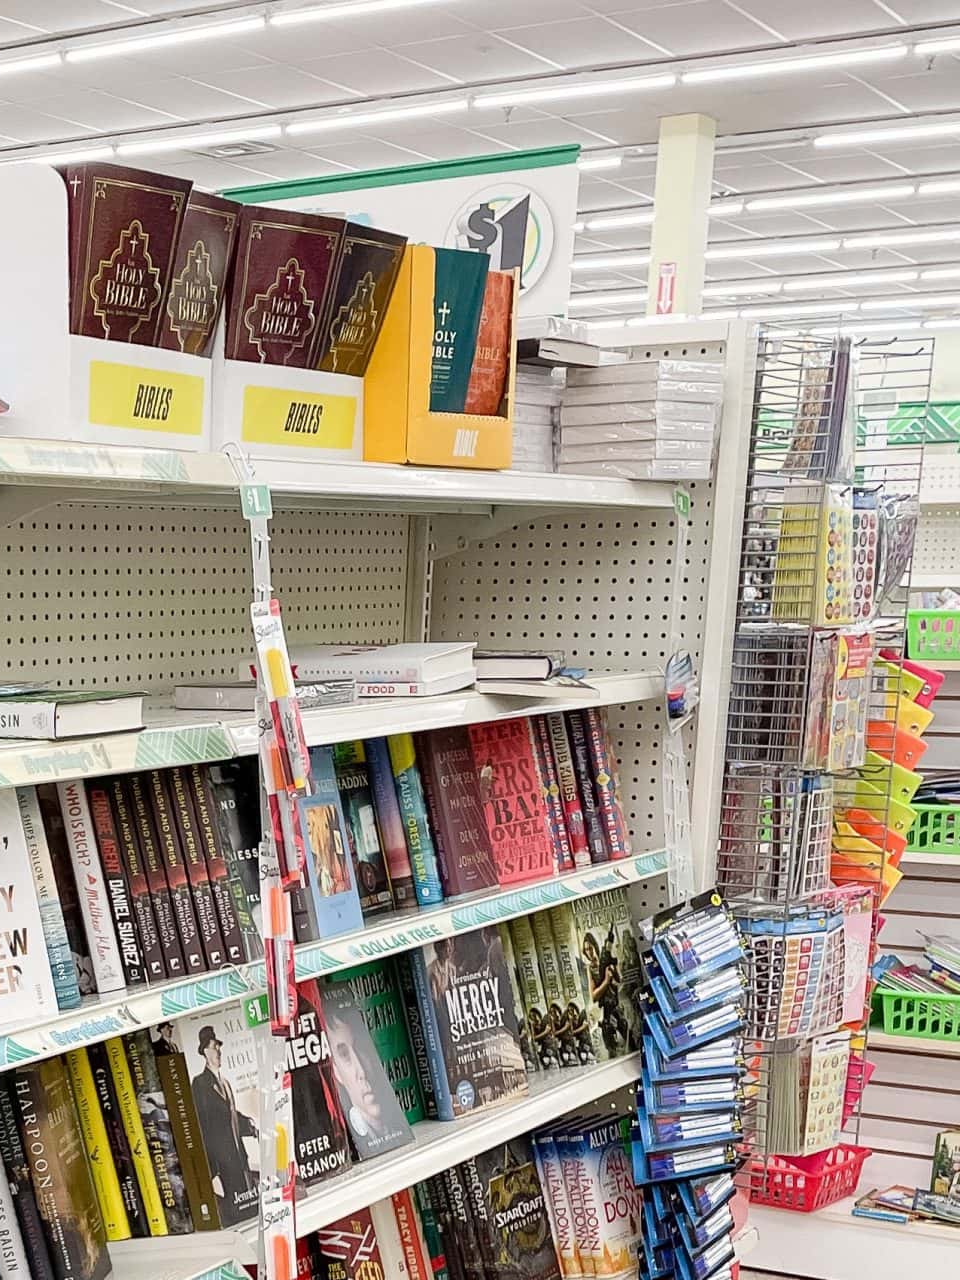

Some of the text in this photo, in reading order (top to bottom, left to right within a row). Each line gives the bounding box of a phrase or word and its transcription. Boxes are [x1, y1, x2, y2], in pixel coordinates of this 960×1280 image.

[115, 264, 144, 285] HOLY
[105, 279, 148, 309] BIBLE
[178, 299, 208, 324] BIBLE
[271, 296, 299, 316] HOLY
[261, 315, 301, 337] BIBLE
[433, 331, 457, 344] OLY
[133, 383, 174, 421] BIBLES
[284, 402, 323, 434] BIBLES
[65, 784, 91, 867] WHO IS RICH?
[151, 771, 177, 868] PUBLISH AND PERISH
[172, 768, 198, 865] PUBLISH AND PERISH
[23, 814, 45, 881] SHIPS FOLLOW
[407, 812, 427, 882] FOREST DARK
[108, 879, 140, 967] DANIEL SUAREZ
[360, 924, 442, 957] DOLLAR TREE
[445, 977, 500, 1024] MERCY
[450, 1007, 505, 1043] STREET
[0, 1089, 24, 1161] ALEXANDRE
[15, 1080, 54, 1189] HARPOON
[590, 1128, 608, 1149] ALLY
[299, 1135, 331, 1158] PETER
[150, 1141, 175, 1208] FIGHTERS
[397, 1206, 412, 1243] TRACY
[556, 1207, 572, 1251] DOWN
[581, 1177, 601, 1251] FALL DOWN
[328, 1263, 342, 1272] THE
[328, 1271, 346, 1280] FEED
